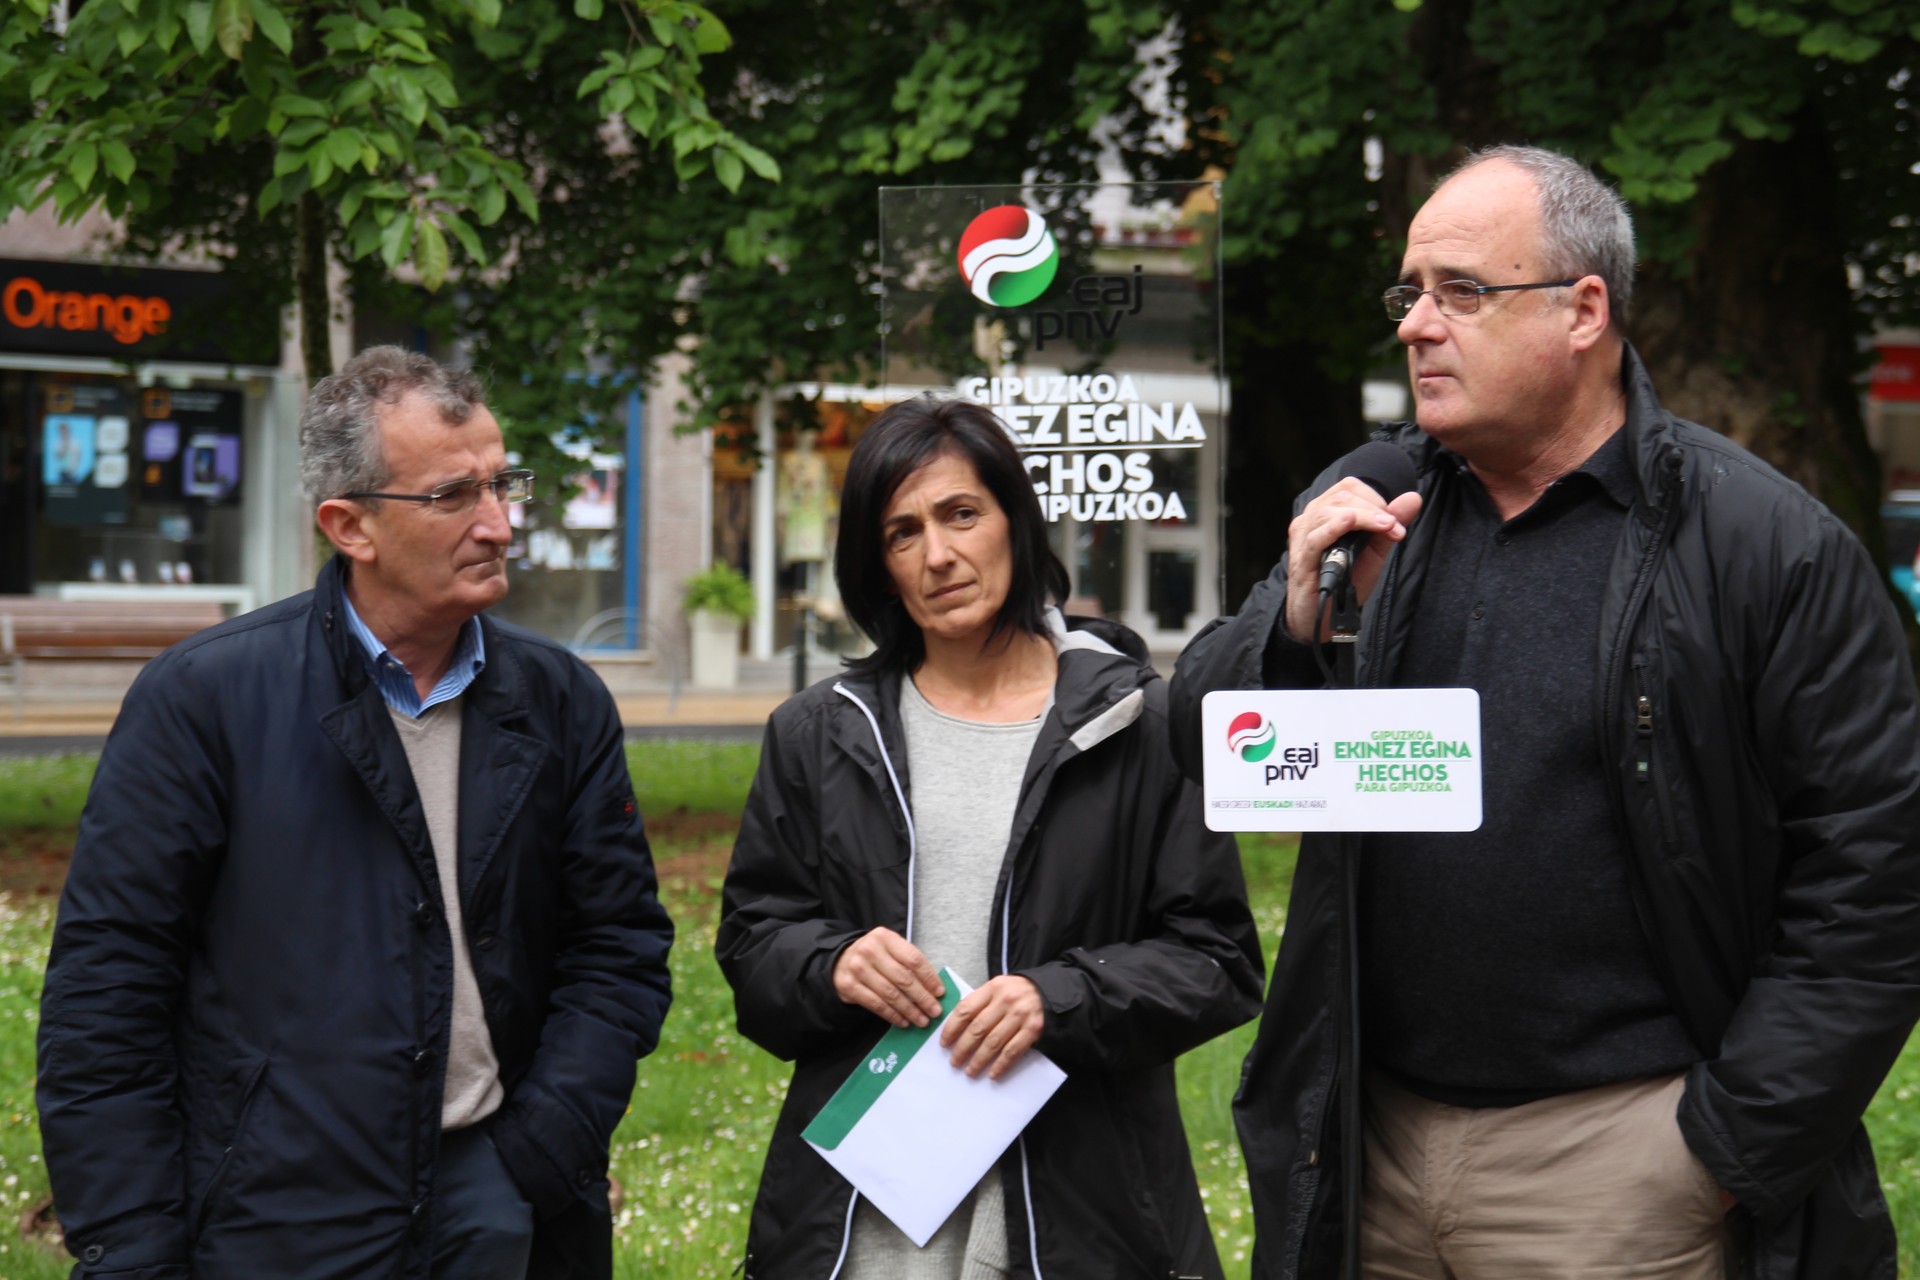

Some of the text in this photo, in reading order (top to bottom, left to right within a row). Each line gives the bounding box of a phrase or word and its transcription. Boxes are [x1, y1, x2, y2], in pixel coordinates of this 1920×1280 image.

[1073, 264, 1143, 315] eaj
[2, 276, 171, 344] Orange
[1035, 309, 1124, 351] pnv
[964, 374, 1139, 406] GIPUZKOA
[1067, 402, 1207, 445] EGINA
[1022, 452, 1154, 495] CHOS
[1038, 491, 1187, 522] IPUZKOA
[1334, 741, 1473, 759] EKINEZ EGINA
[1370, 730, 1434, 741] GIPUZKOA
[1283, 742, 1319, 768] eaj
[1265, 765, 1310, 786] pnv
[1355, 782, 1453, 792] PARA GIPUZKOA
[1358, 763, 1449, 781] HECHOS
